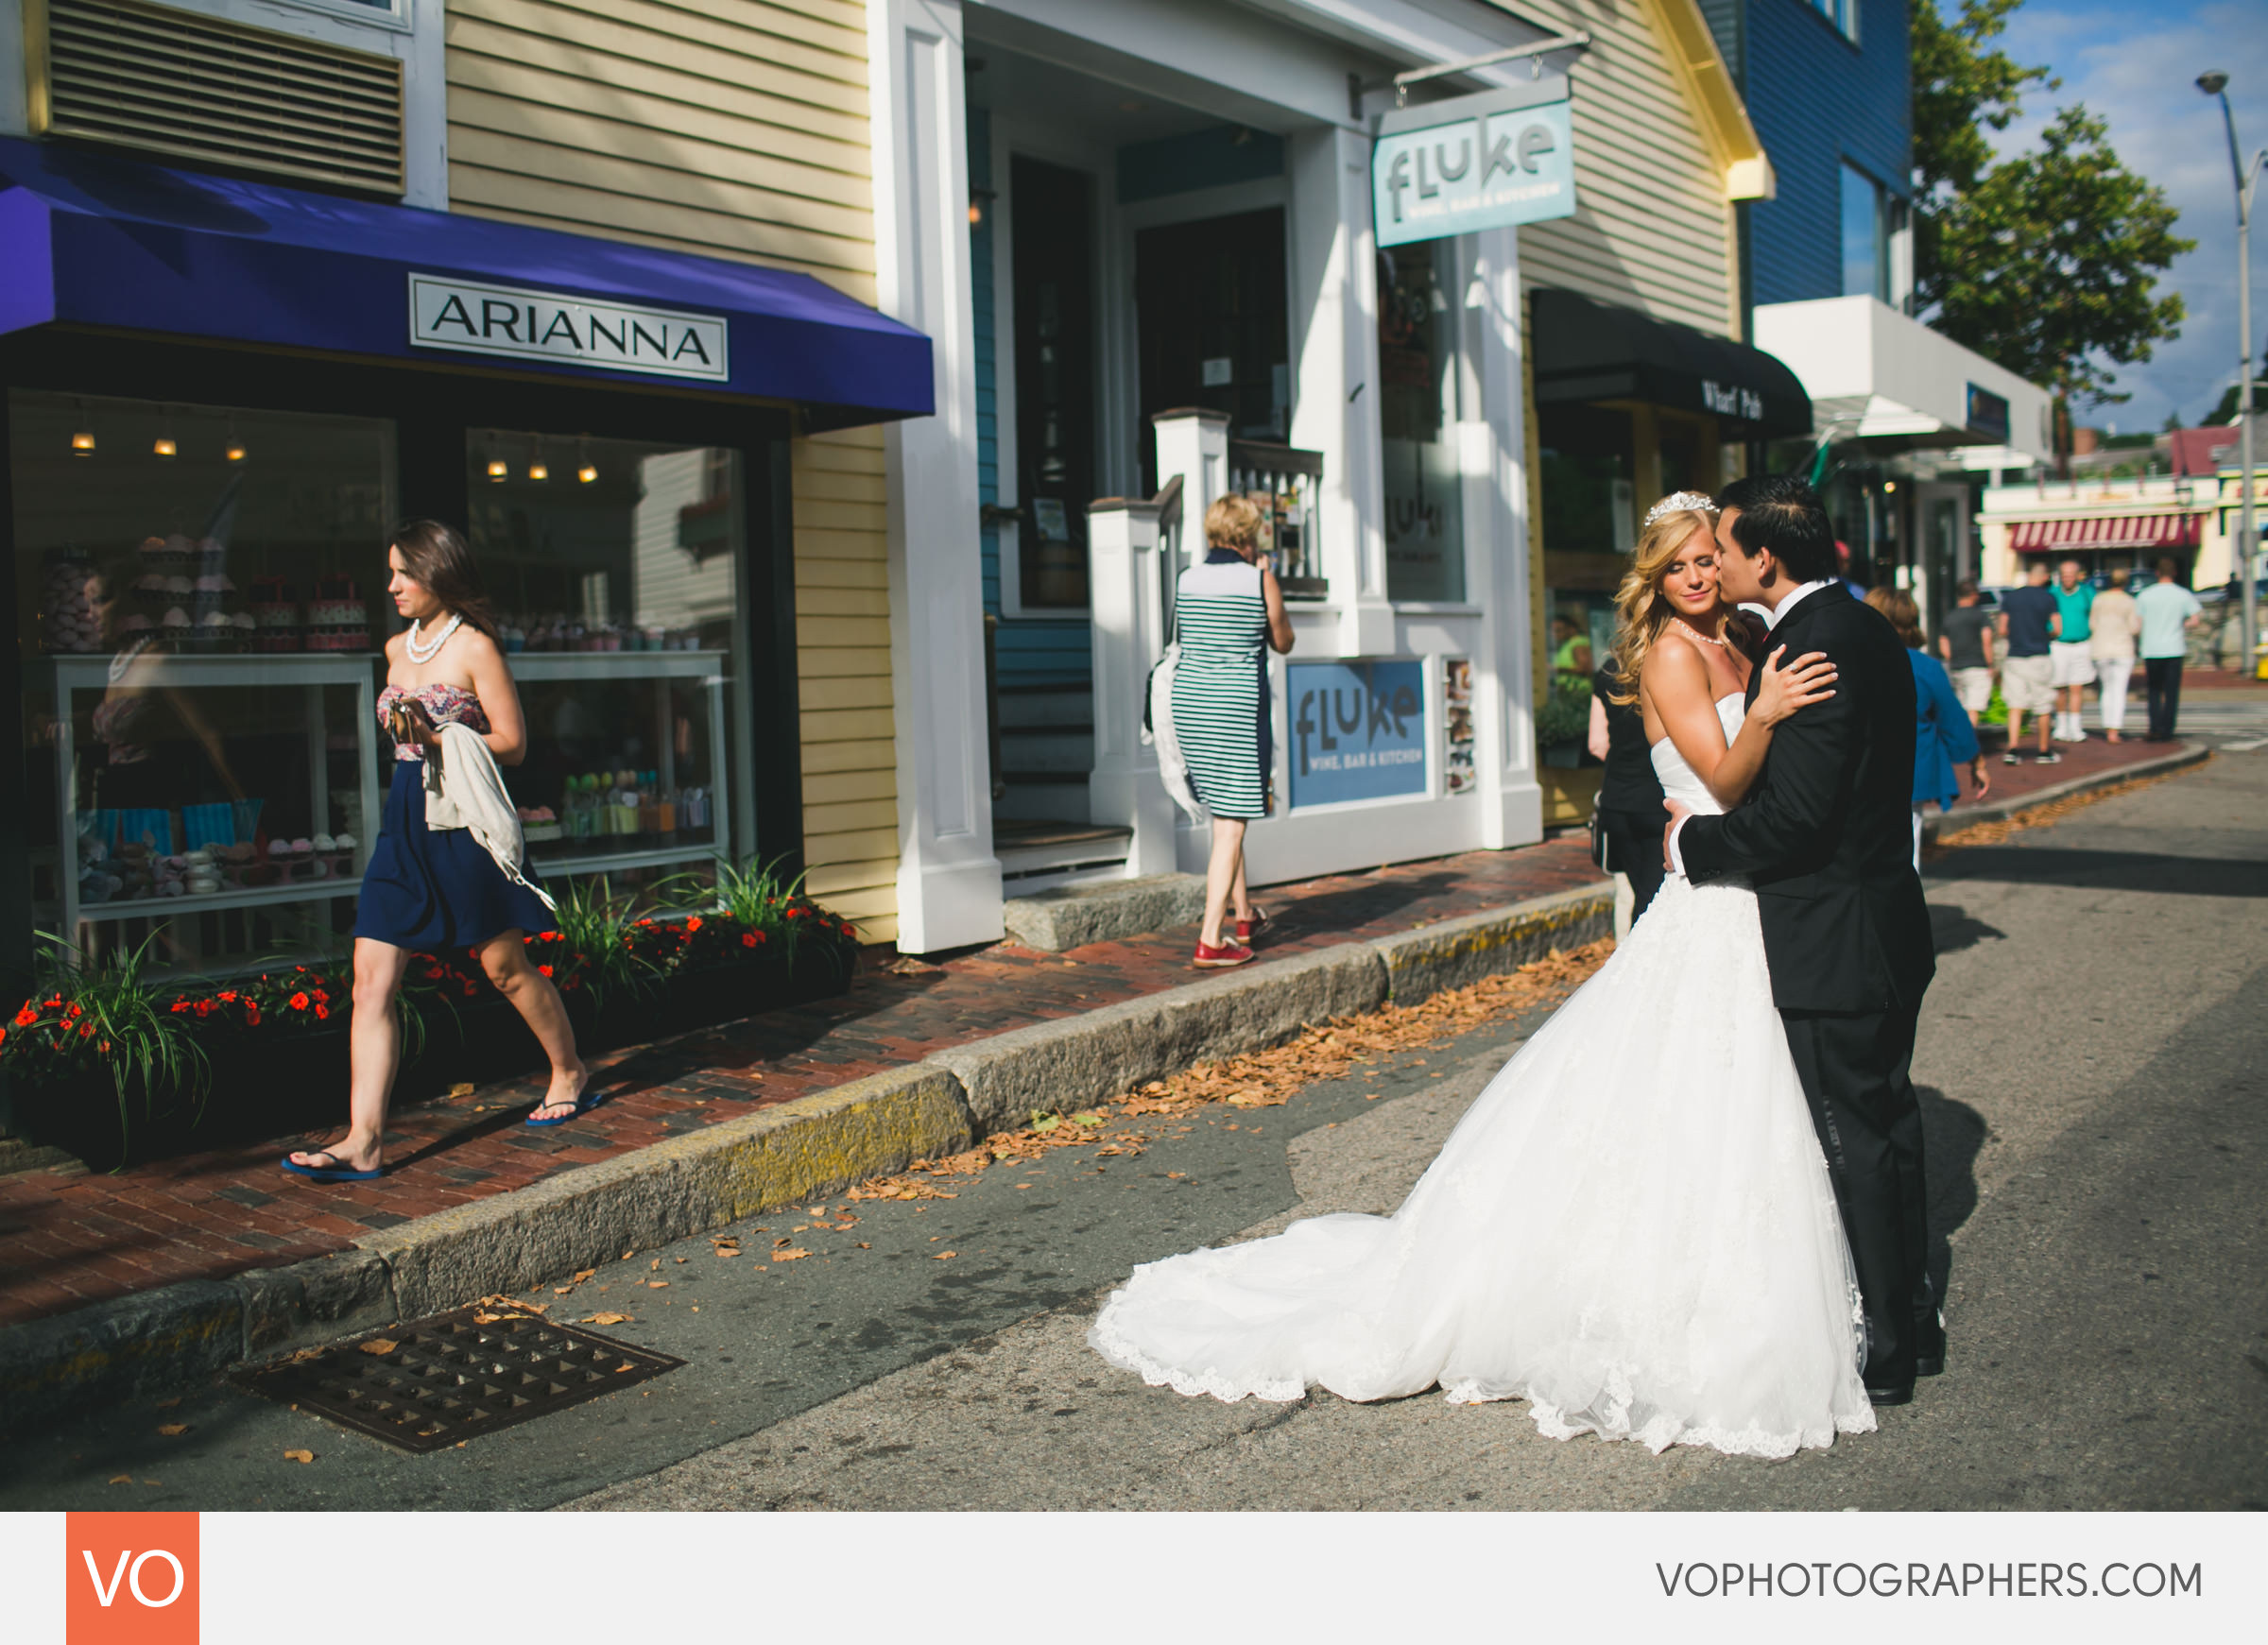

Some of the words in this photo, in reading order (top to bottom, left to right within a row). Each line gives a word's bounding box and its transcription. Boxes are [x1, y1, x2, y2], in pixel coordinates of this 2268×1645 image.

[431, 294, 711, 365] ARIANNA
[1344, 752, 1366, 769] BAR
[1368, 751, 1377, 767] &
[1378, 748, 1423, 766] KITCHEN
